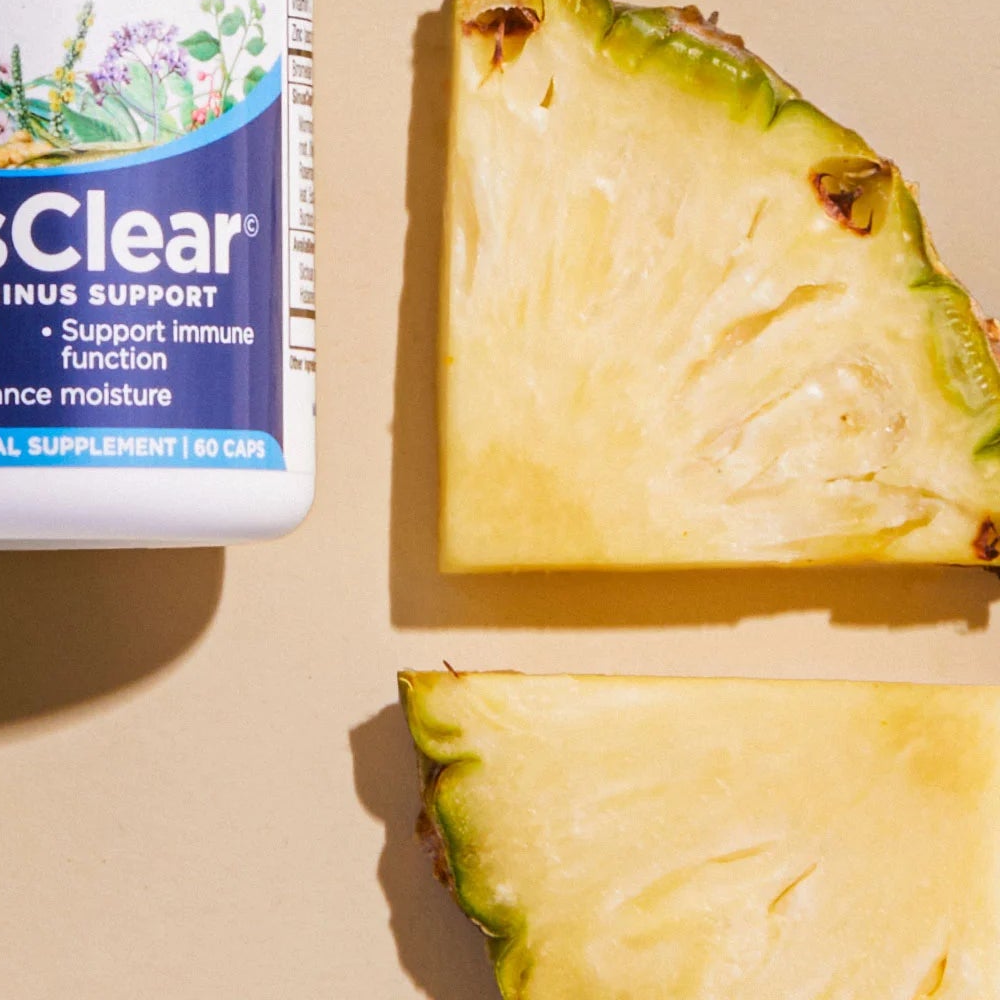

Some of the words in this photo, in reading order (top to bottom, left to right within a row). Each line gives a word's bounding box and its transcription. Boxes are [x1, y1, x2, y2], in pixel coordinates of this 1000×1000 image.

[88, 284, 218, 307] SUPPORT
[62, 319, 166, 346] Support
[173, 319, 254, 345] immune
[61, 347, 167, 371] function
[61, 382, 172, 408] moisture
[28, 436, 177, 458] SUPPLEMENT
[194, 439, 220, 458] 60
[223, 439, 266, 459] CAPS
